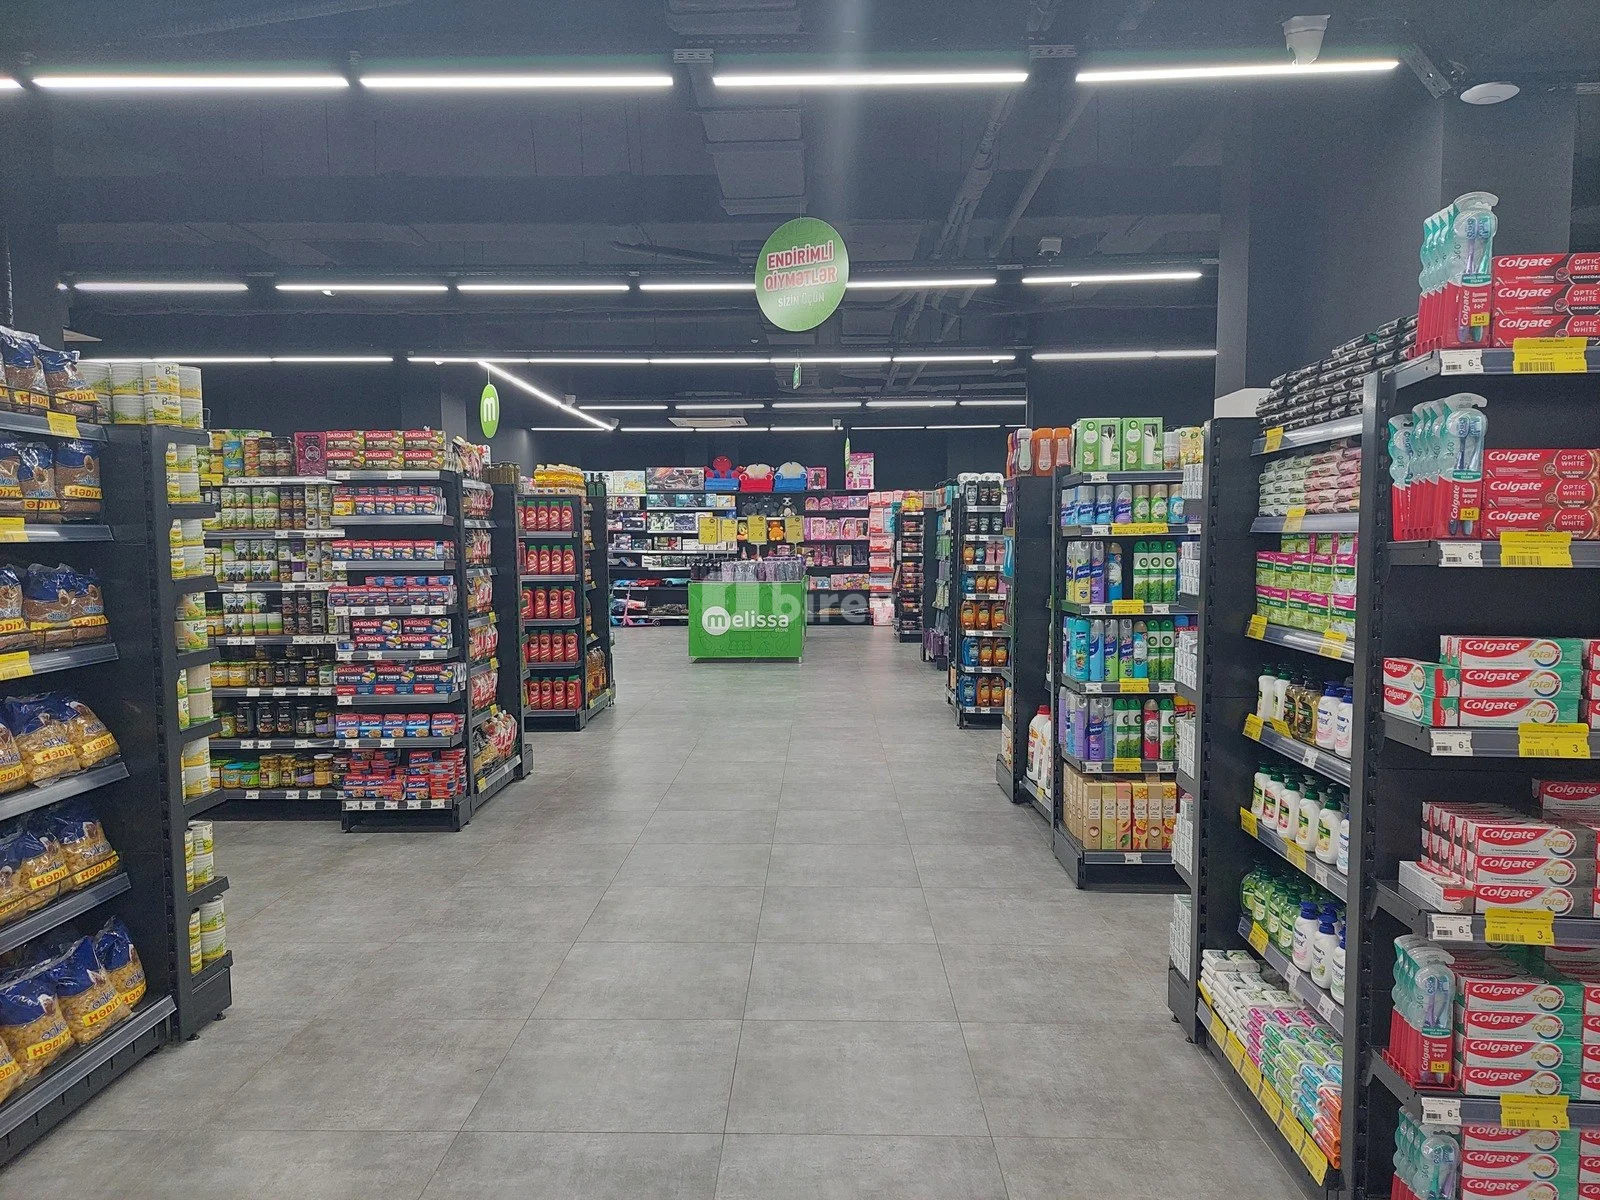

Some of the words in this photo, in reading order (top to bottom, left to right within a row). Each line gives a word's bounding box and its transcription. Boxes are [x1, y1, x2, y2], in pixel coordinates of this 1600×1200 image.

[767, 241, 833, 269] ENDİRİMLİ
[1498, 257, 1553, 269] Colgate
[765, 267, 836, 291] QİYMƏTLƏR
[1498, 288, 1552, 299] Colgate
[1461, 290, 1470, 326] Colgate
[1499, 318, 1552, 330] Colgate
[1488, 451, 1540, 463] Colgate
[1490, 481, 1542, 492] Colgate
[1451, 485, 1461, 520] Colgate
[1488, 510, 1541, 522] Colgate
[1468, 552, 1474, 560] 6
[703, 608, 789, 630] melissa
[1465, 640, 1520, 652] Colgate
[1528, 649, 1554, 658] Total
[1384, 661, 1407, 673] Colgate
[1466, 670, 1520, 682] Colgate
[1528, 679, 1554, 688] Total
[1384, 688, 1407, 700] Colgate
[1463, 700, 1518, 711] Colgate
[1525, 708, 1551, 717] Total
[1572, 744, 1578, 752] 3
[1546, 784, 1597, 795] Colgate
[1482, 828, 1536, 839] Colgate
[1543, 838, 1568, 847] Total
[1481, 857, 1535, 869] Colgate
[1543, 867, 1568, 876] Total
[1479, 886, 1533, 898] Colgate
[1541, 897, 1566, 906] Total
[1458, 926, 1464, 934] 6
[1537, 931, 1543, 939] 3
[1472, 984, 1525, 995] Colgate
[1532, 994, 1557, 1003] Total
[1471, 1012, 1523, 1024] Colgate
[1531, 1023, 1556, 1032] Total
[1470, 1041, 1523, 1053] Colgate
[1421, 1039, 1430, 1071] Colgate
[1530, 1051, 1555, 1060] Total
[1469, 1069, 1521, 1081] Colgate
[1529, 1080, 1554, 1088] Total
[1552, 1115, 1558, 1124] 3
[1469, 1125, 1521, 1137] Colgate
[1466, 1152, 1519, 1163] Colgate
[1528, 1162, 1552, 1171] Total
[1466, 1180, 1519, 1191] Colgate
[1527, 1191, 1552, 1199] Total
